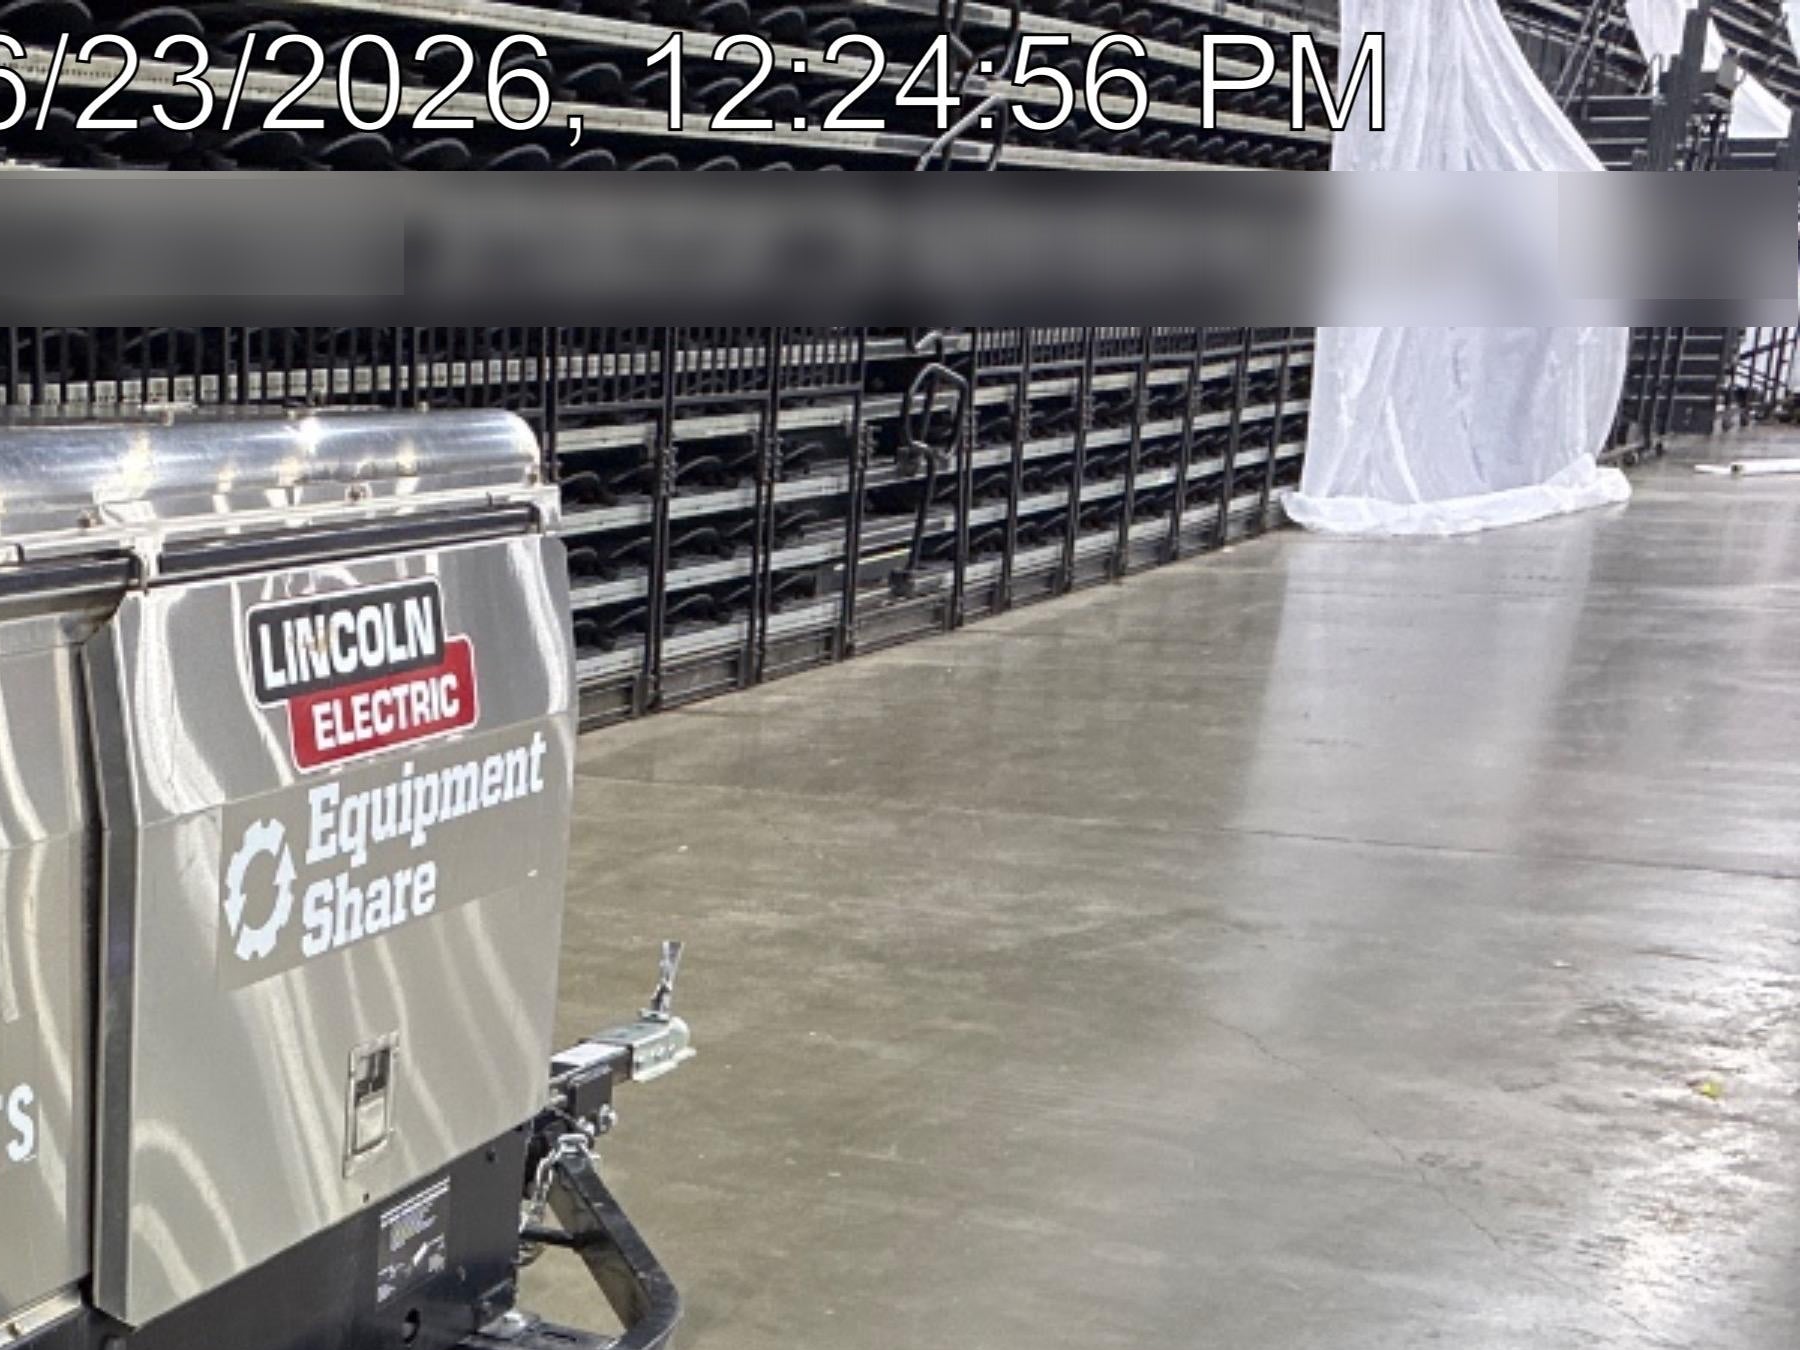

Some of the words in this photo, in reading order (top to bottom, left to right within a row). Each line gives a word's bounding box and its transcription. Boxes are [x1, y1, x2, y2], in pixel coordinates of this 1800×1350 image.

[260, 597, 436, 689] LINCOLN
[312, 673, 459, 752] ELECTRIC
[305, 731, 548, 867] Equipment
[302, 860, 437, 959] Share
